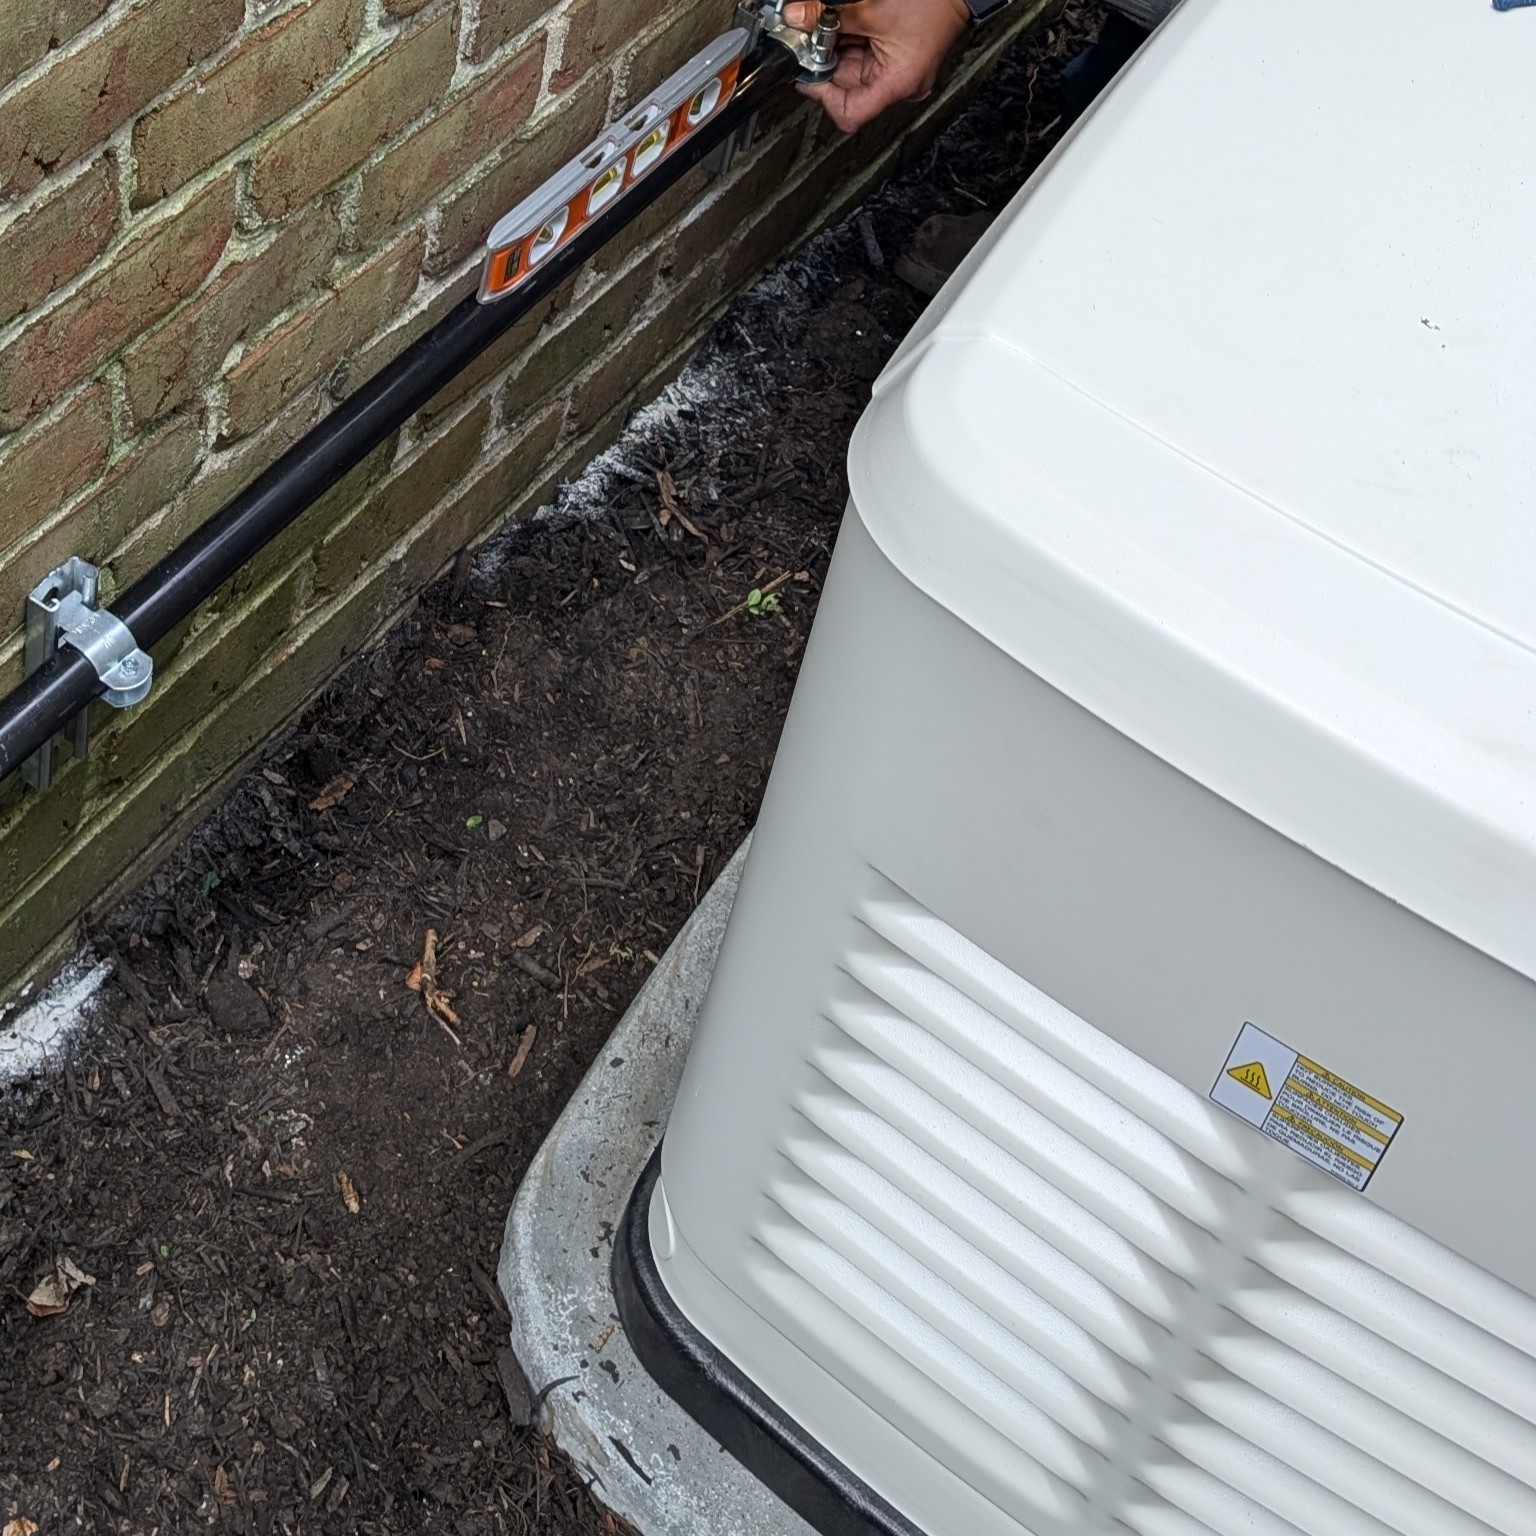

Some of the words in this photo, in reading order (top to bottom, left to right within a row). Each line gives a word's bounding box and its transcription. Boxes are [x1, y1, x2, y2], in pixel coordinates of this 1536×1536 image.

[1296, 1064, 1311, 1075] HOT
[1284, 1086, 1322, 1111] SURFACES
[1294, 1069, 1305, 1078] TO
[1306, 1076, 1336, 1096] REDUCE
[1338, 1095, 1352, 1106] THE
[1354, 1105, 1371, 1117] RISK
[1373, 1117, 1384, 1125] OF
[1321, 1091, 1332, 1100] DO
[1333, 1099, 1348, 1110] NOT
[1332, 1078, 1366, 1100] CAUTION
[1279, 1095, 1289, 1103] DE
[1329, 1126, 1340, 1134] NE
[1341, 1133, 1355, 1144] PAS
[1282, 1091, 1303, 1105] POUR
[1342, 1127, 1351, 1135] LE
[1352, 1134, 1380, 1153] RISQUE
[1316, 1097, 1356, 1124] ATTENTION
[1269, 1117, 1288, 1131] PARA
[1289, 1130, 1322, 1152] REDUCIR
[1267, 1122, 1276, 1130] DE
[1332, 1163, 1343, 1172] NO
[1345, 1171, 1360, 1182] LAS
